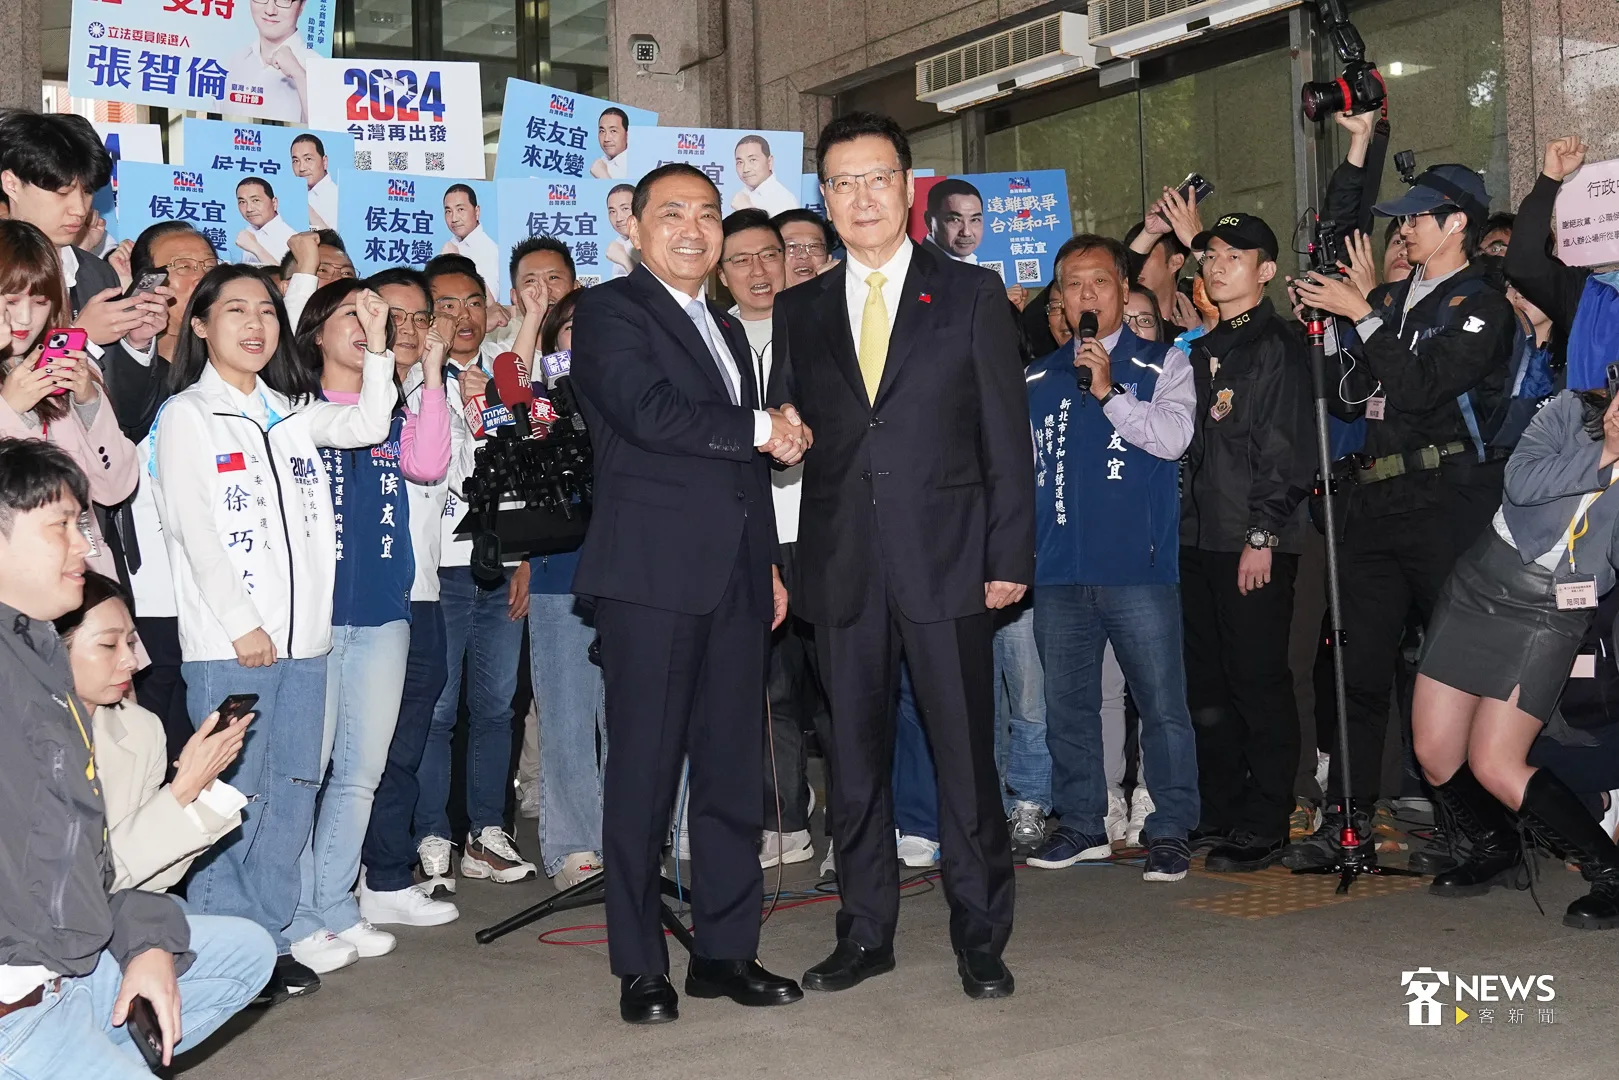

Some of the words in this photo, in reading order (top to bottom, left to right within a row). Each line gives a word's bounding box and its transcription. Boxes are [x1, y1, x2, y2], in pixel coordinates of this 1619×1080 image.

[108, 26, 190, 48] 立法委員候選人
[86, 44, 229, 100] 張智倫
[344, 68, 446, 122] 2024
[550, 93, 575, 113] 2024
[234, 128, 261, 146] 2024
[347, 123, 447, 142] 台灣再出發
[526, 115, 588, 150] 侯友宜
[677, 133, 705, 149] 2024
[521, 144, 585, 178] 來改變
[173, 170, 204, 188] 2024
[388, 178, 415, 196] 2024
[548, 184, 577, 200] 2024
[149, 194, 227, 223] 侯友宜
[987, 193, 1058, 213] 遠離戰爭
[365, 205, 434, 235] 侯友宜
[526, 211, 598, 237] 侯友宜
[990, 213, 1060, 233] 台海和平
[1217, 216, 1240, 227] SSC
[364, 236, 433, 265] 來改變
[1010, 241, 1047, 255] 侯友宜
[379, 472, 400, 559] 侯友宜
